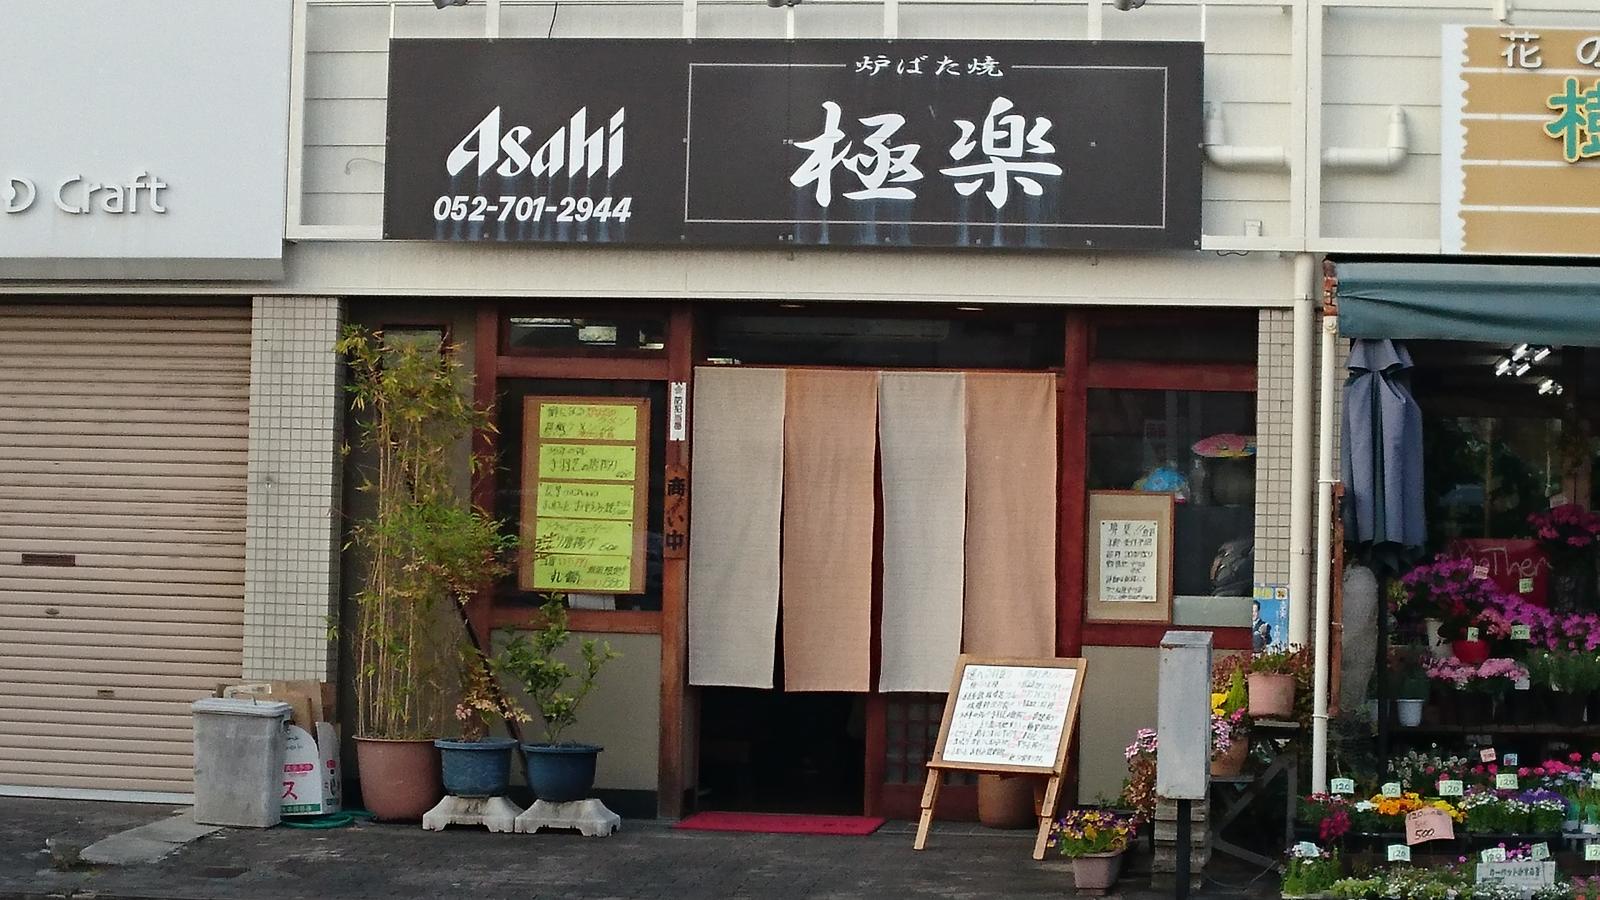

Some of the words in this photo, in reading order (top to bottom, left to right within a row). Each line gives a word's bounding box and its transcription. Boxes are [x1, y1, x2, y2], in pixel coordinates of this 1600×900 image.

[855, 54, 1005, 78] 炉ばた焼
[446, 105, 625, 178] Asahi
[789, 96, 1063, 209] 極楽
[56, 171, 167, 214] Craft
[433, 195, 632, 224] 052-701-2944
[1336, 783, 1350, 791] 120
[1415, 828, 1435, 840] 500
